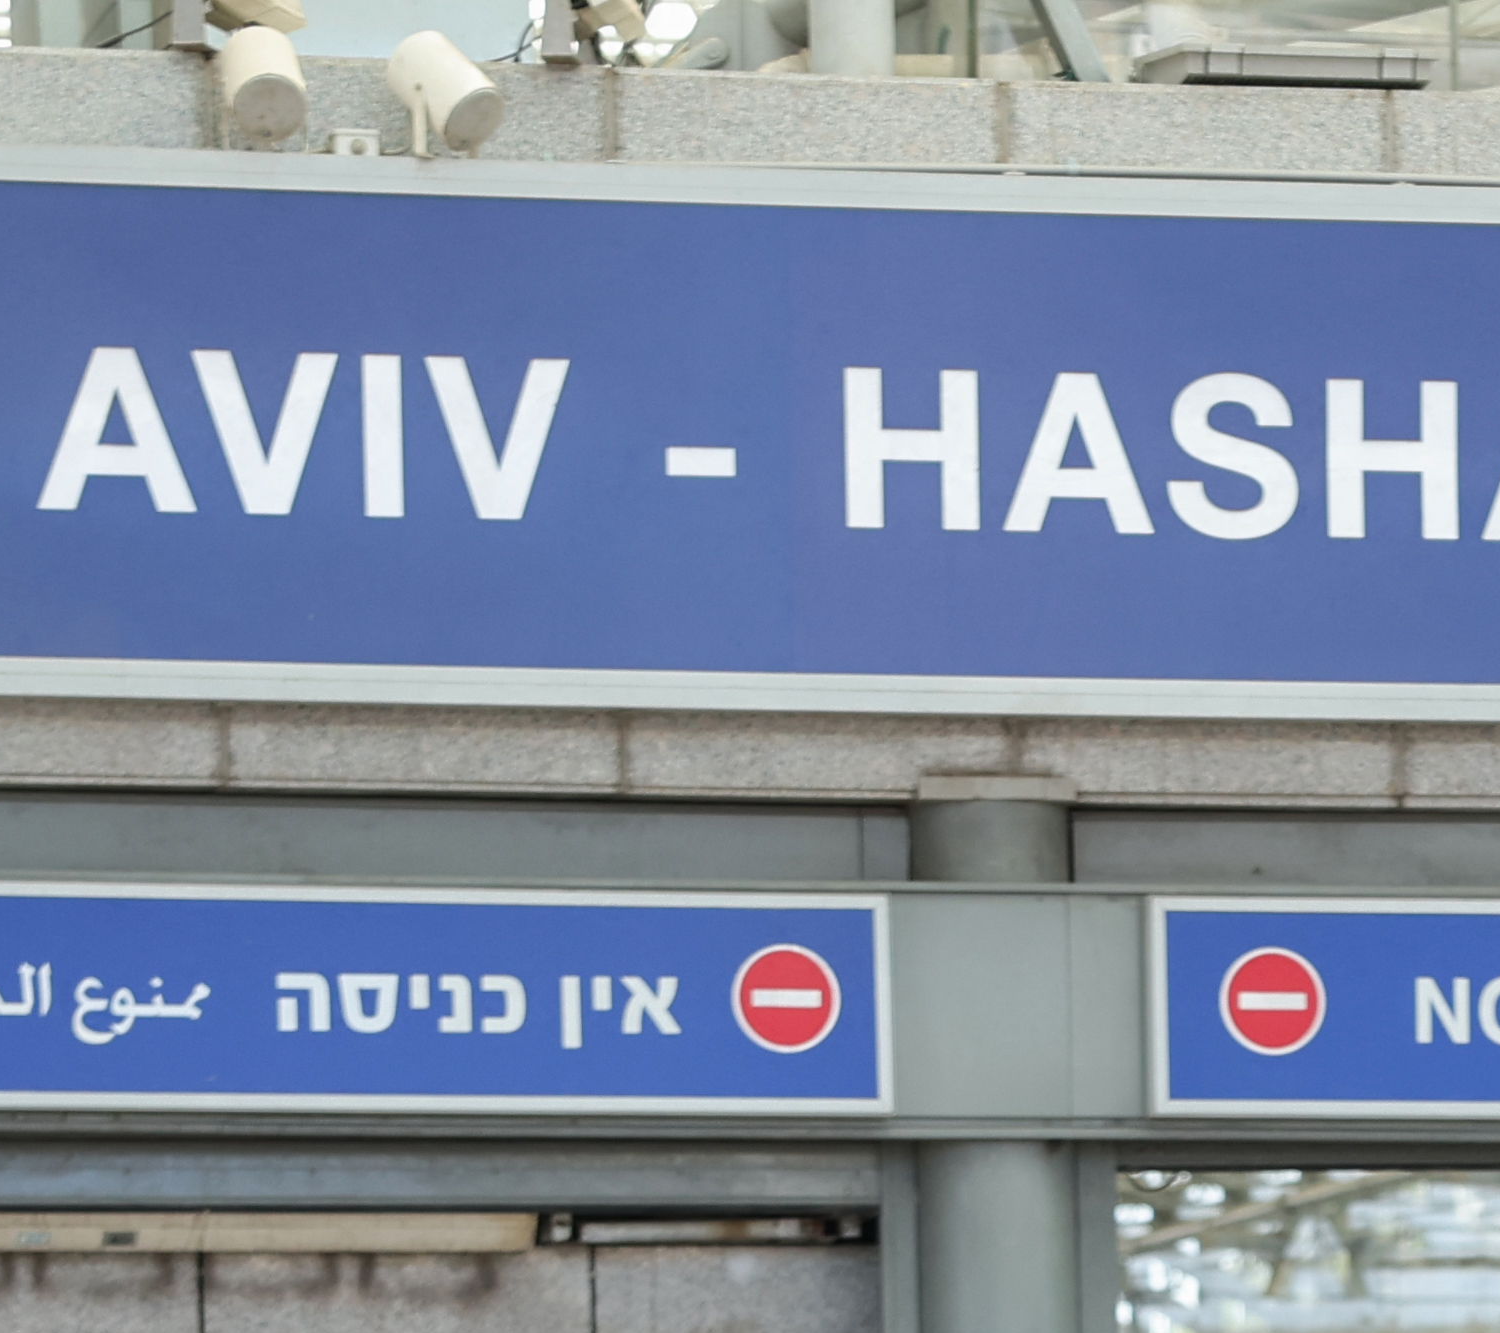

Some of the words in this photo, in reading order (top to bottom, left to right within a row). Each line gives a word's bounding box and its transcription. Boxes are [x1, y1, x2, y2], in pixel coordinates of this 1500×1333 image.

[36, 346, 571, 520] AVIV
[665, 446, 737, 477] -
[276, 972, 527, 1034] כניסה
[560, 975, 682, 1050] אין
